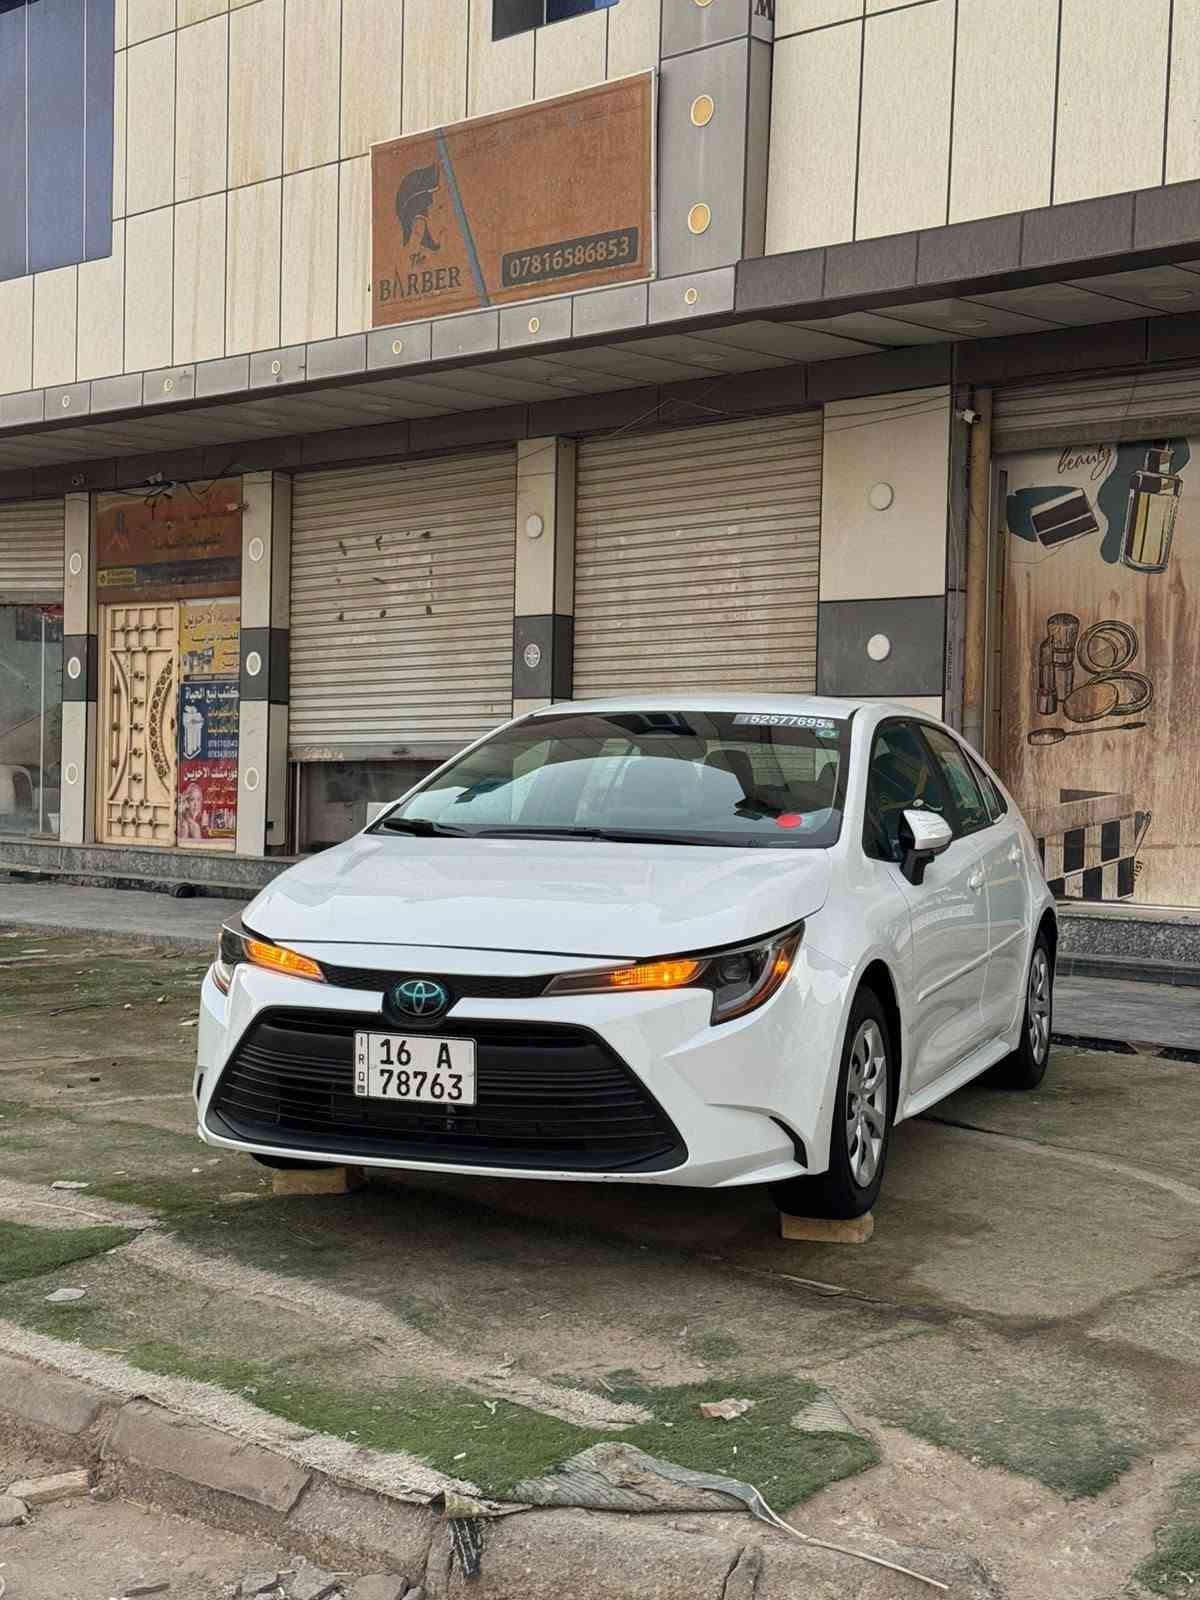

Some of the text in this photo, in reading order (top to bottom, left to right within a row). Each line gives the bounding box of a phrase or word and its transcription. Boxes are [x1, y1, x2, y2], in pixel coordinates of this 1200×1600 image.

[510, 236, 630, 279] 07816586853
[379, 264, 462, 302] BARBER
[1057, 442, 1111, 481] beauty
[380, 1038, 453, 1069] 16 A
[379, 1068, 463, 1100] 78763
